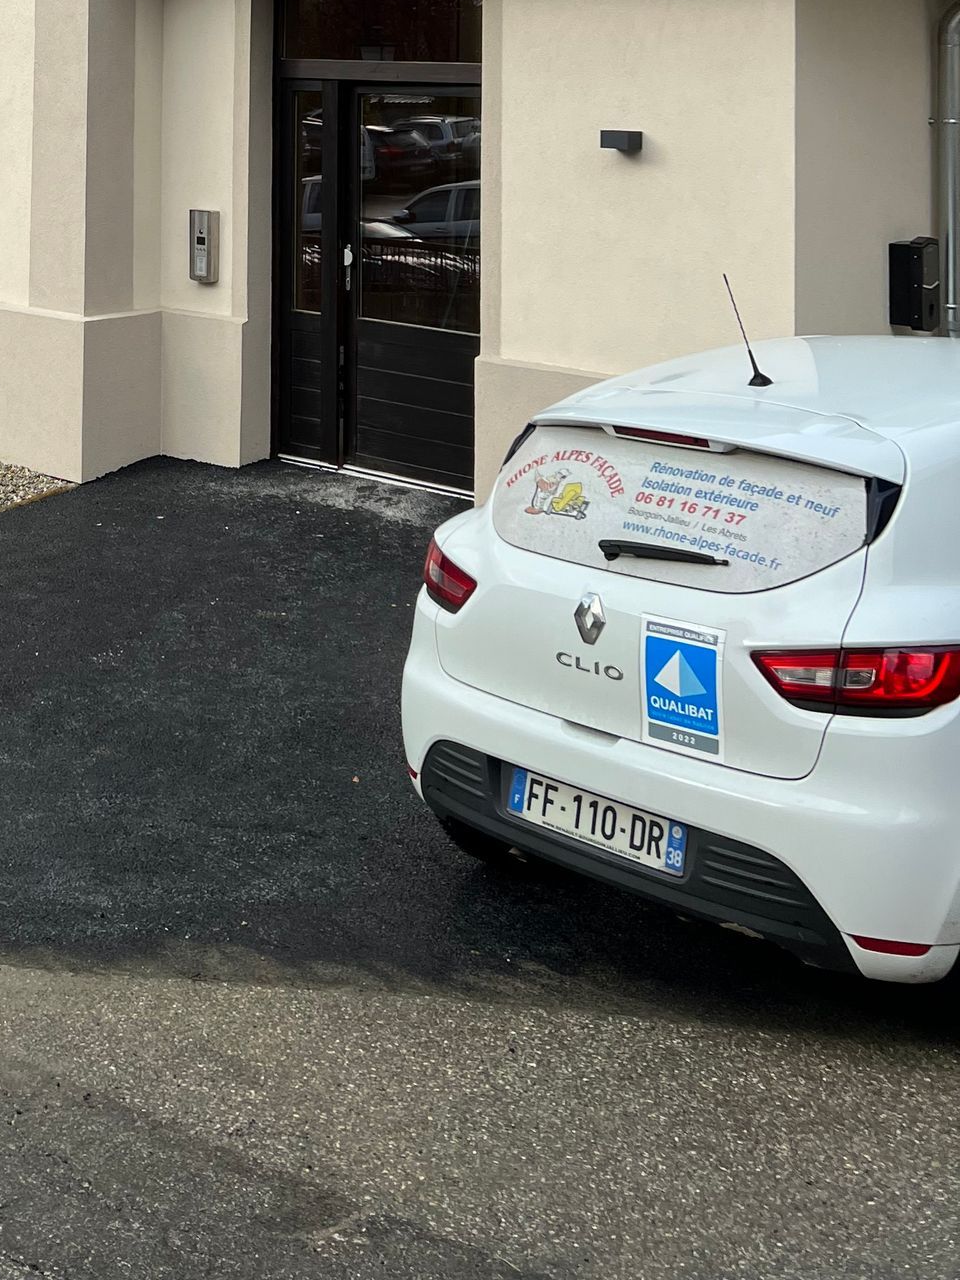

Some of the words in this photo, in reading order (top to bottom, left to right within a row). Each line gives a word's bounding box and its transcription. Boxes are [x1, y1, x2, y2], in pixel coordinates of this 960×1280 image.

[551, 449, 594, 464] ALPES
[590, 455, 626, 499] FAÇADE
[649, 461, 716, 485] Rénovation
[718, 474, 736, 488] de
[737, 478, 784, 500] façade
[786, 492, 803, 506] et
[804, 500, 841, 519] neuf
[634, 491, 655, 505] 06
[656, 495, 675, 509] 81
[679, 501, 699, 514] 16
[702, 505, 721, 520] 71
[724, 511, 747, 526] 37
[641, 476, 693, 497] Isolation
[694, 487, 759, 512] extérieure
[622, 519, 782, 571] www.rhone-alpes-facade.fr
[701, 523, 718, 535] Les
[717, 527, 748, 542] Abrets
[555, 651, 624, 681] CLIO
[650, 695, 714, 721] QUALIBAT
[672, 732, 696, 745] 2022
[514, 793, 521, 804] F
[526, 777, 665, 860] FF-110-DR
[666, 847, 683, 867] 38
